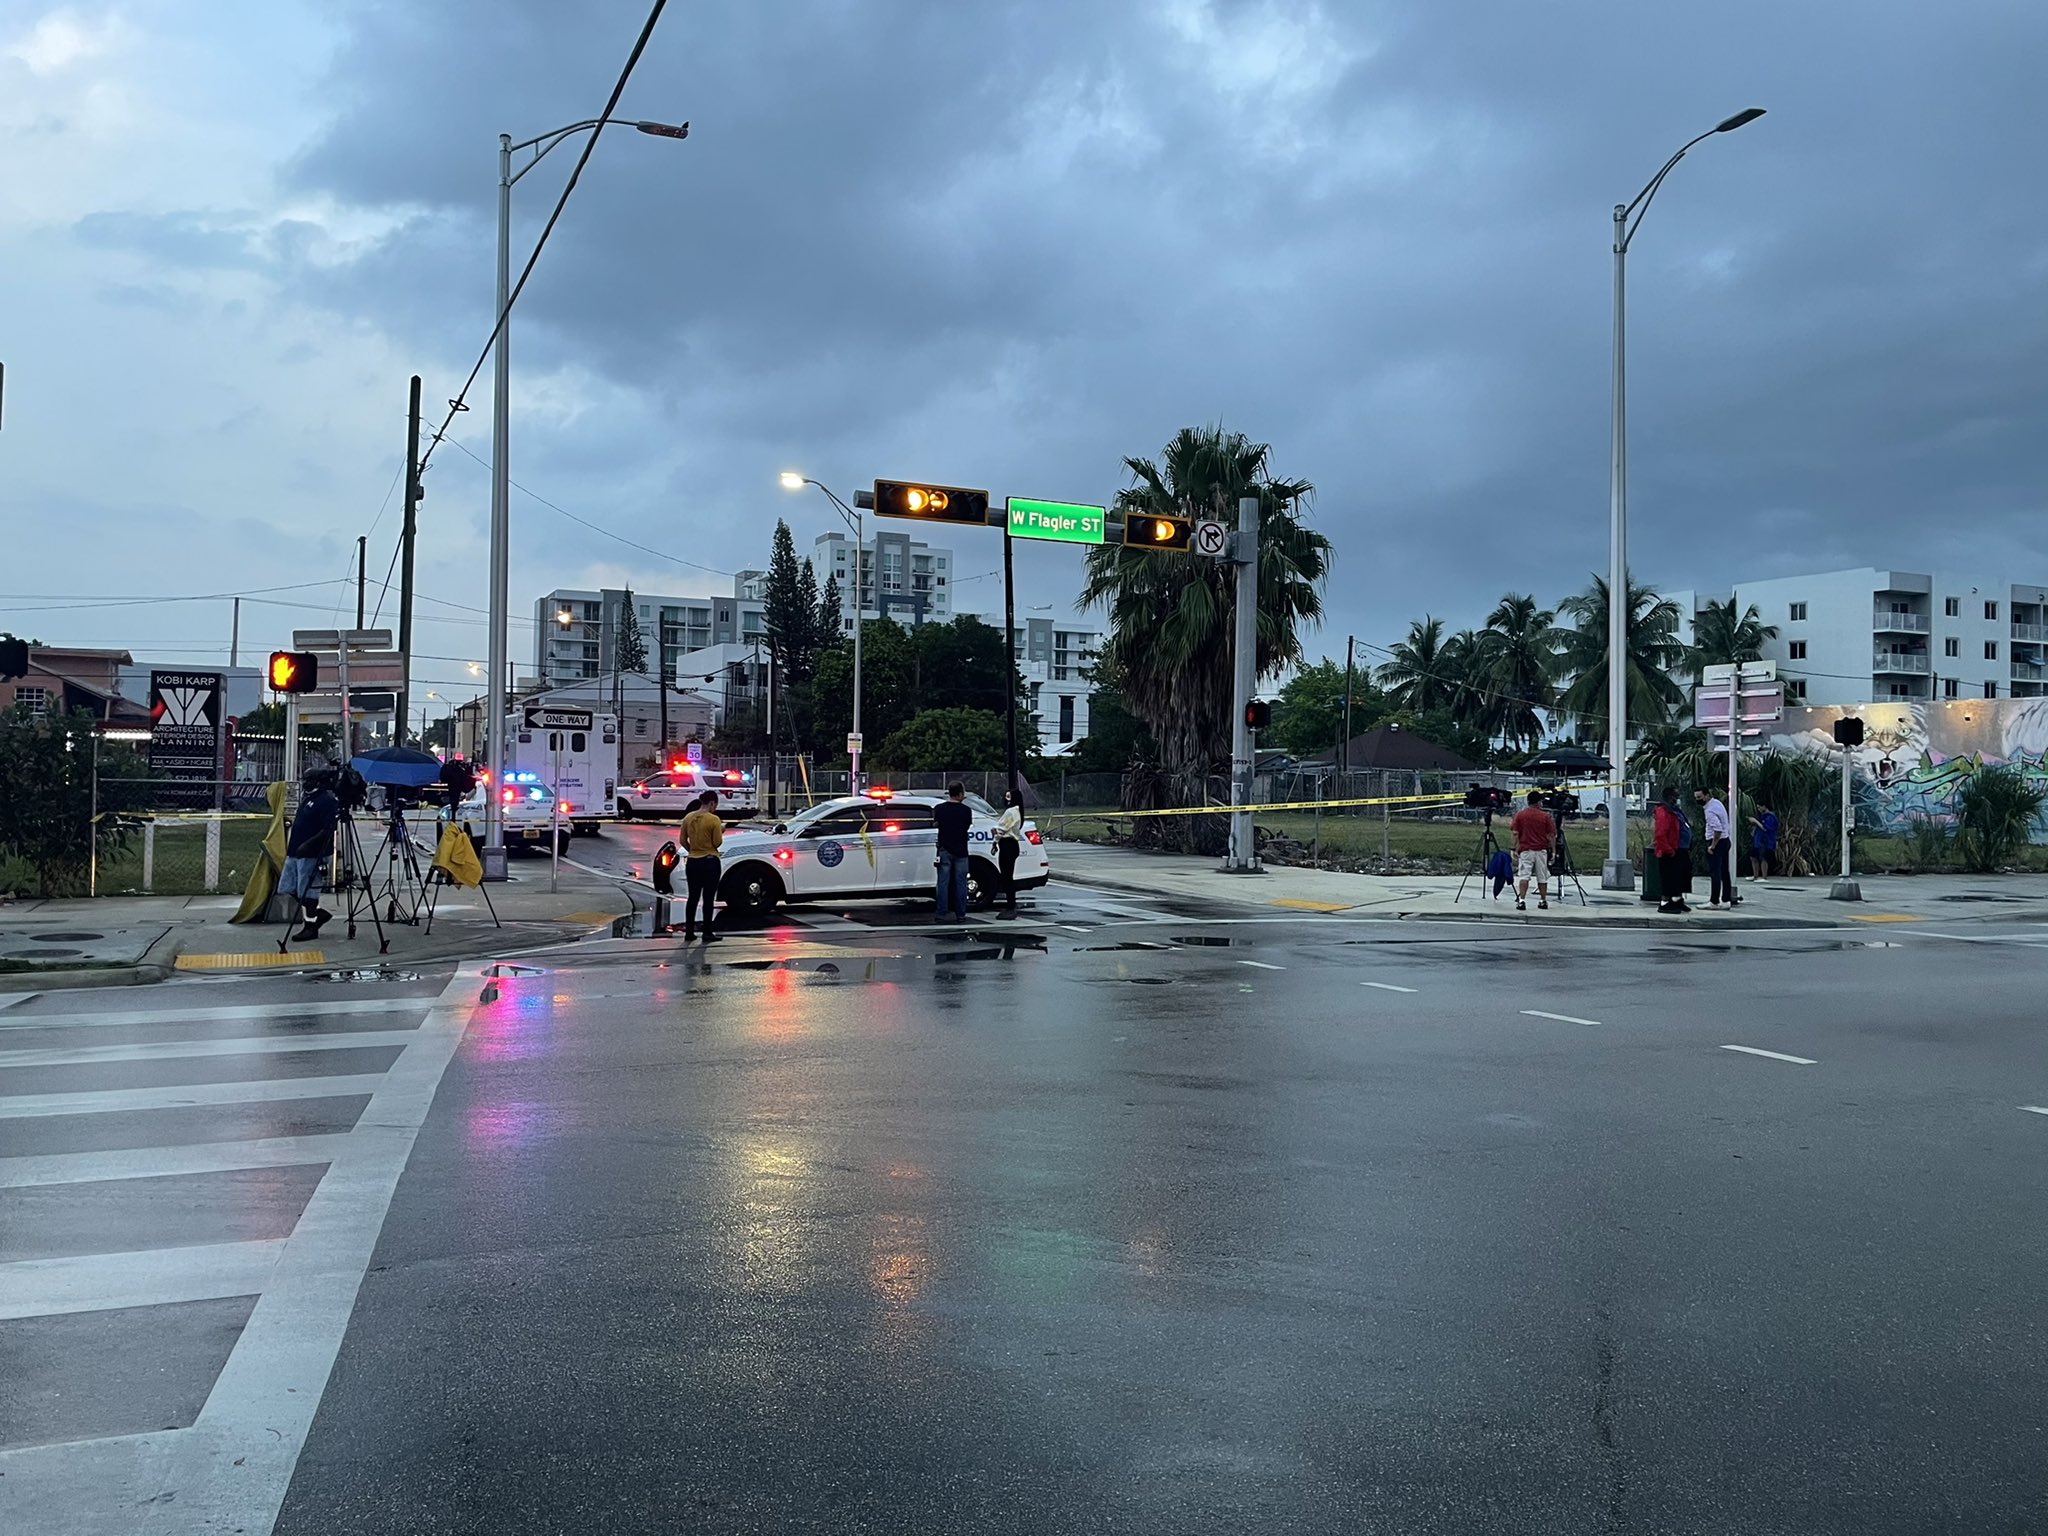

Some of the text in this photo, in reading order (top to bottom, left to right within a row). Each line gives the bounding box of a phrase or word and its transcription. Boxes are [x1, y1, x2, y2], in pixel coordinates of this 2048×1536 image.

[1012, 510, 1100, 533] W Flagler ST
[156, 675, 216, 686] KOBI KARP
[545, 714, 587, 725] ONE WAY
[153, 725, 215, 733] ARCHITECTURE
[152, 738, 215, 747] PLANNING
[689, 751, 701, 759] 30
